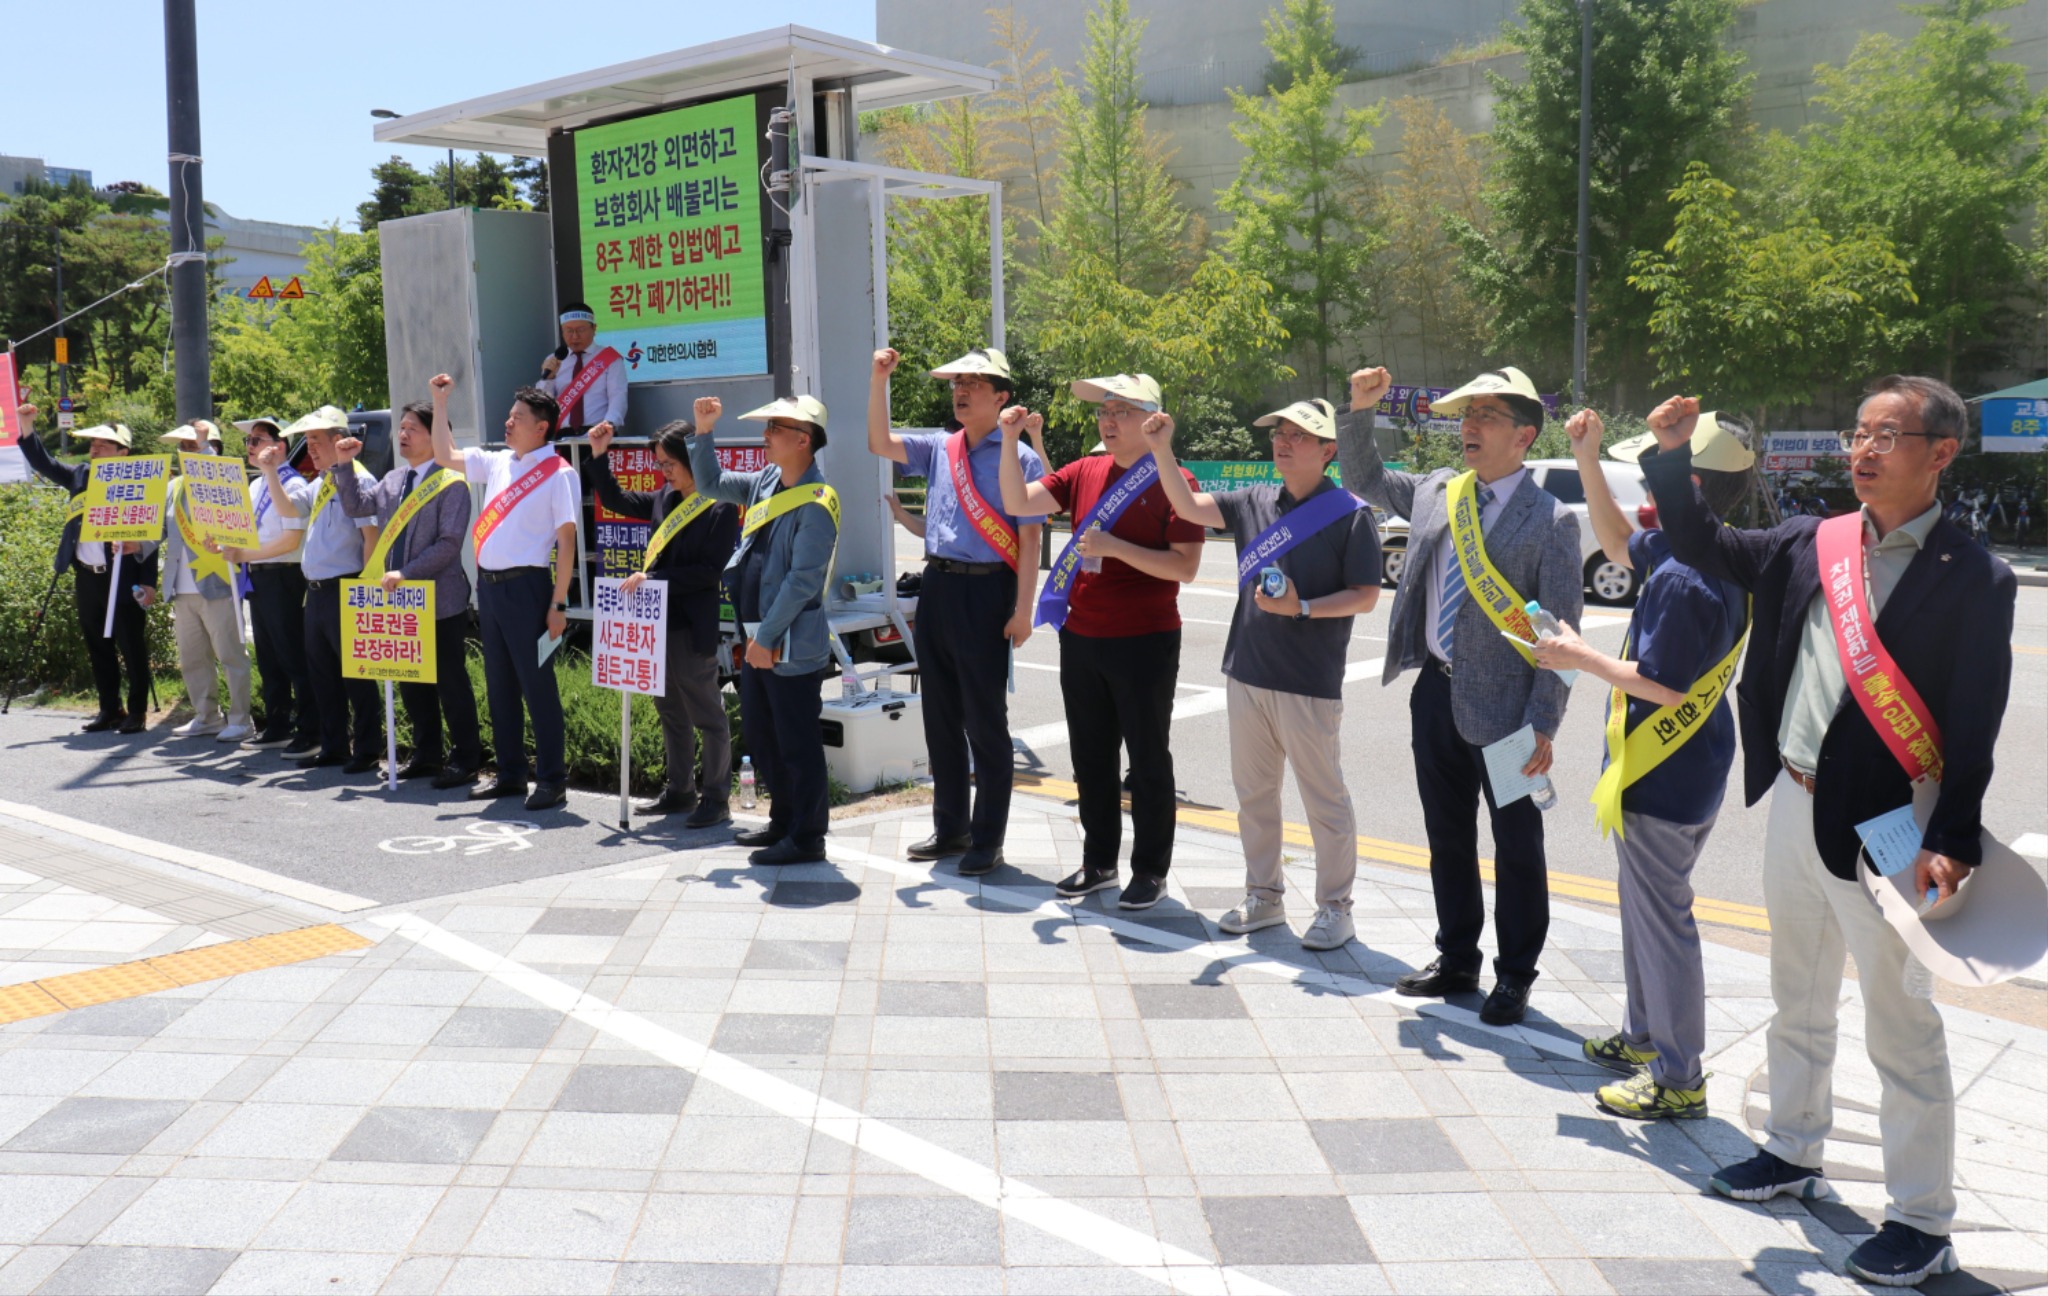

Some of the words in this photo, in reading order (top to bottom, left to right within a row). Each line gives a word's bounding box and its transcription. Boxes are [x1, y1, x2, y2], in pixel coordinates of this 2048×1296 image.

[591, 140, 658, 184] 환자건강
[664, 127, 737, 170] 외면하고
[594, 187, 661, 228] 보험회사
[666, 175, 739, 218] 배불리는
[596, 240, 624, 273] 8주
[628, 234, 663, 270] 제한
[668, 224, 741, 266] 입법예고
[609, 283, 642, 318] 즉각
[647, 272, 732, 315] 폐기하라!!
[647, 340, 717, 363] 대한한의사협회
[2011, 419, 2040, 435] 8주
[95, 460, 164, 482] 자동차보험회사
[735, 449, 766, 472] 교통사
[1221, 463, 1268, 478] 보험회사
[106, 484, 145, 502] 배부르고
[189, 482, 243, 507] 자동차보험회사
[1198, 480, 1230, 492] 자건강
[87, 507, 119, 526] 국민들은
[122, 504, 158, 525] 신음한다!
[597, 525, 629, 547] 교통사고
[631, 525, 651, 547] 피해
[603, 548, 647, 571] 진료권
[1462, 529, 1485, 580] 치료받을
[1476, 575, 1513, 614] 권리를
[1503, 608, 1539, 645] 보장하
[1829, 557, 1853, 608] 치료권
[348, 586, 384, 608] 교통사고
[597, 585, 624, 617] 국토부의
[355, 611, 418, 636] 진료권을
[599, 619, 656, 656] 사고환자
[1839, 603, 1878, 676] 제한하는
[353, 638, 422, 664] 보장하라!
[597, 652, 657, 691] 힘든고통!
[1861, 671, 1923, 740] 졸속입법
